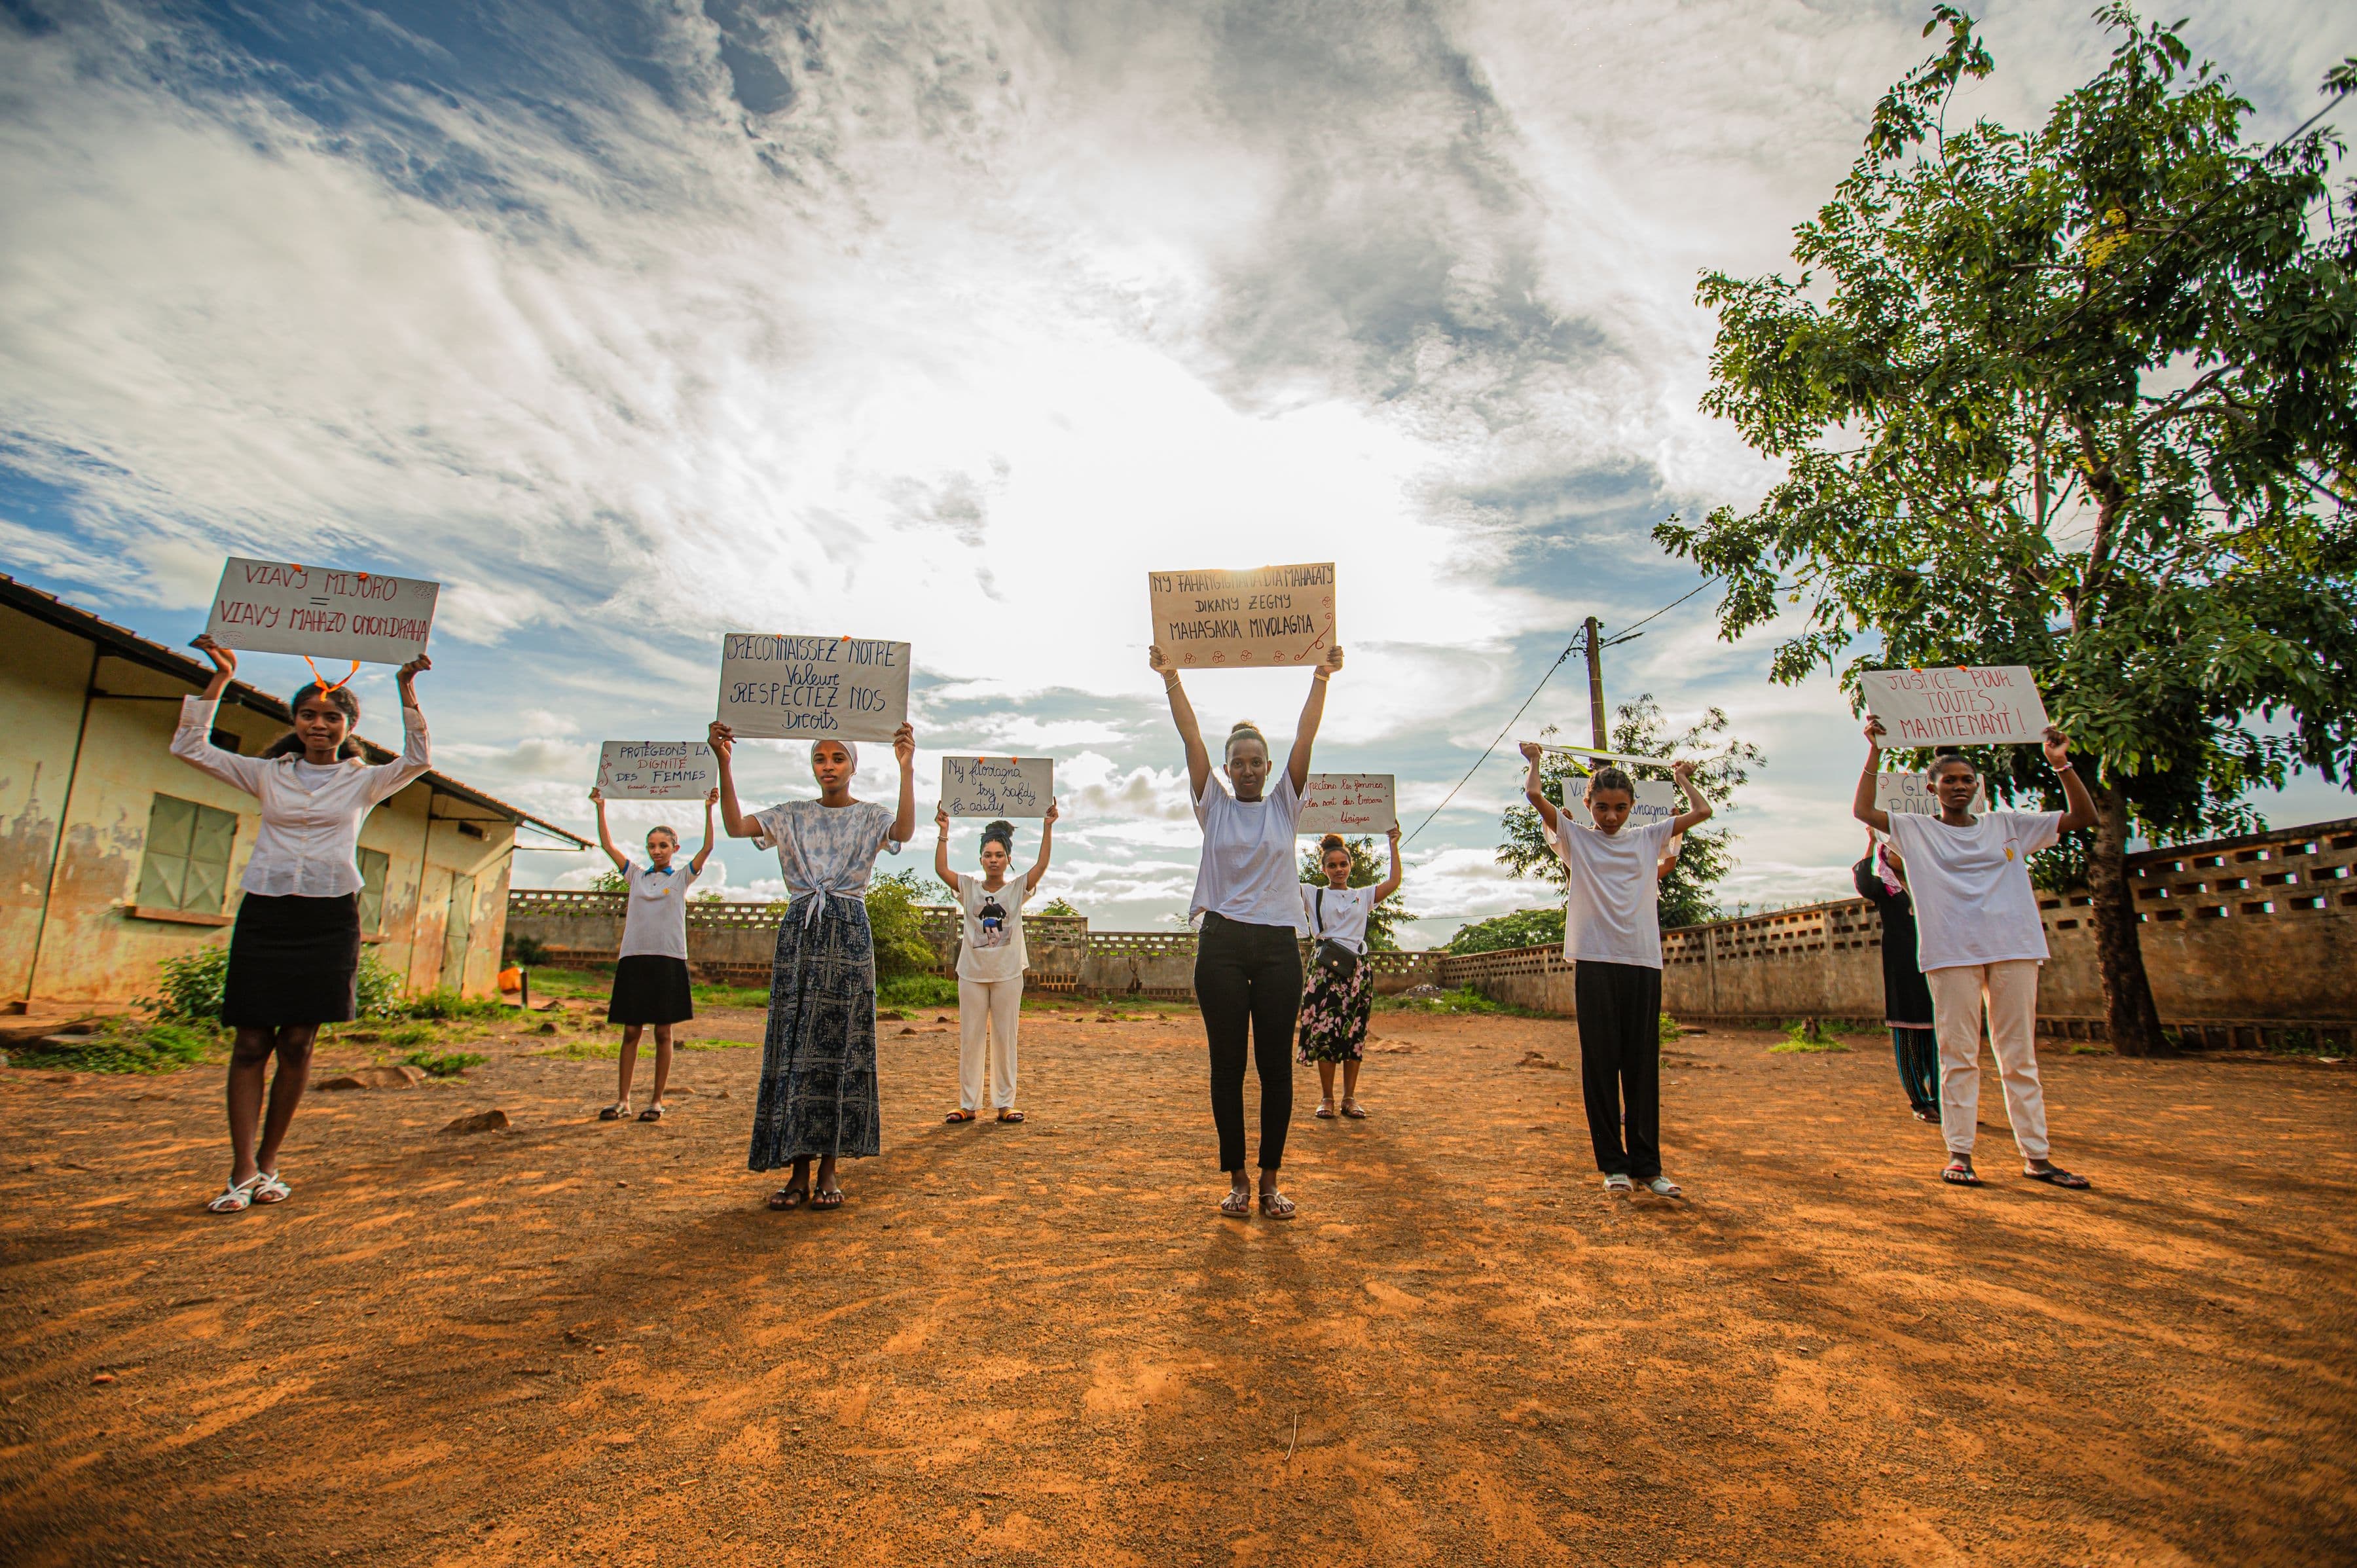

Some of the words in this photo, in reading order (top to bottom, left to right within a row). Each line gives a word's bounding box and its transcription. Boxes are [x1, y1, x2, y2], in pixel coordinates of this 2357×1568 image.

[246, 564, 308, 589] VIAVY
[324, 572, 397, 601] MIJORO
[1152, 574, 1171, 593] NY
[1195, 596, 1239, 613] DIKANY
[1249, 594, 1291, 610] ZEGNY
[220, 600, 280, 628] VIAVY
[289, 607, 346, 633] MAHAZO
[1169, 619, 1242, 640] MAHASAKIA
[1249, 613, 1315, 638] MIVOLAGNA
[727, 634, 839, 662] RECONNAISSEZ
[848, 640, 896, 666] NOTRE
[1887, 671, 1958, 690] JUSTICE
[1969, 669, 2015, 687] POUR
[729, 682, 839, 708] RESPECTEZ
[850, 685, 886, 712] NOS
[695, 745, 710, 756] LA
[615, 773, 638, 782] DES
[653, 770, 706, 784] FEMMES
[949, 759, 964, 784] Ny
[976, 781, 996, 803] tsy
[1002, 782, 1036, 807] safidy
[1323, 796, 1337, 807] sont
[1342, 795, 1355, 806] des
[949, 797, 966, 815] fa
